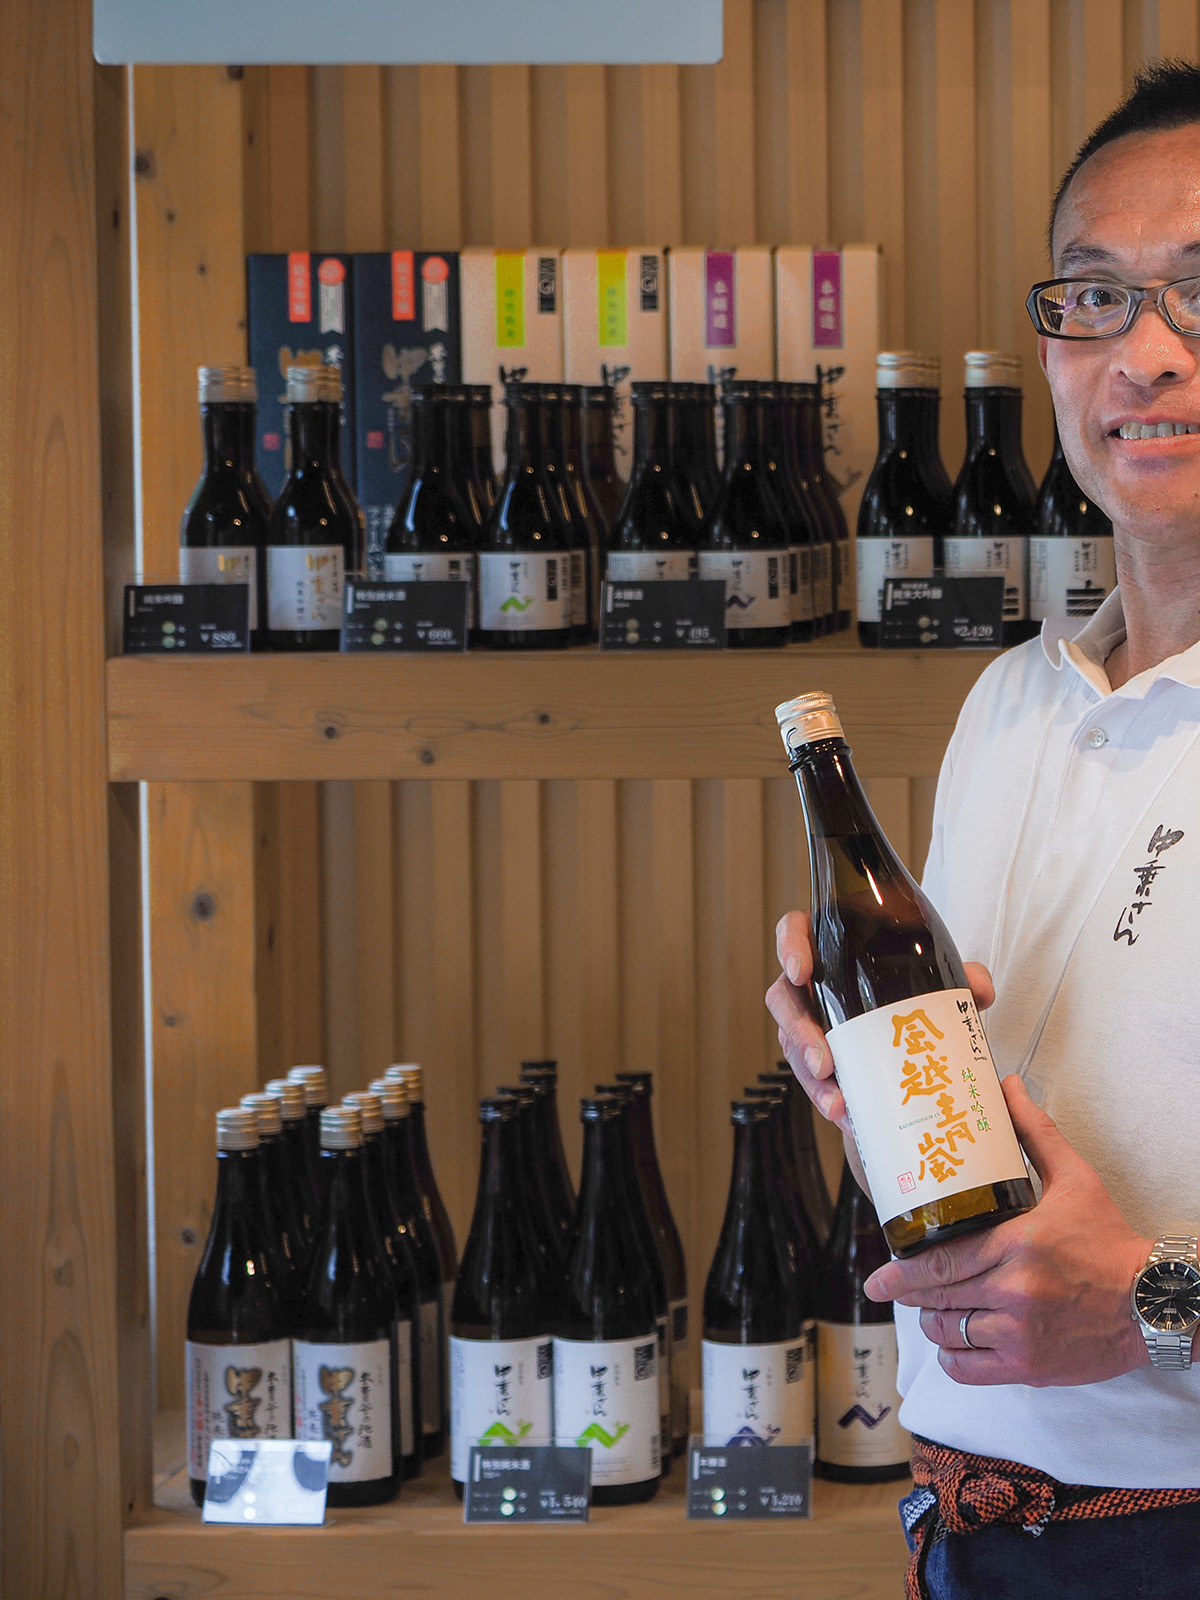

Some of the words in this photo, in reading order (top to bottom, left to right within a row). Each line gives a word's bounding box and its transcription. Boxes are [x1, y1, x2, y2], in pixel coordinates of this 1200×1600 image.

[893, 588, 942, 600] 純米大吟醸
[1113, 824, 1185, 946] 中乗さん
[892, 1009, 976, 1183] 風越青嵐
[961, 1067, 992, 1133] 純米吟醸
[265, 1371, 278, 1438] 木曽谷の地
